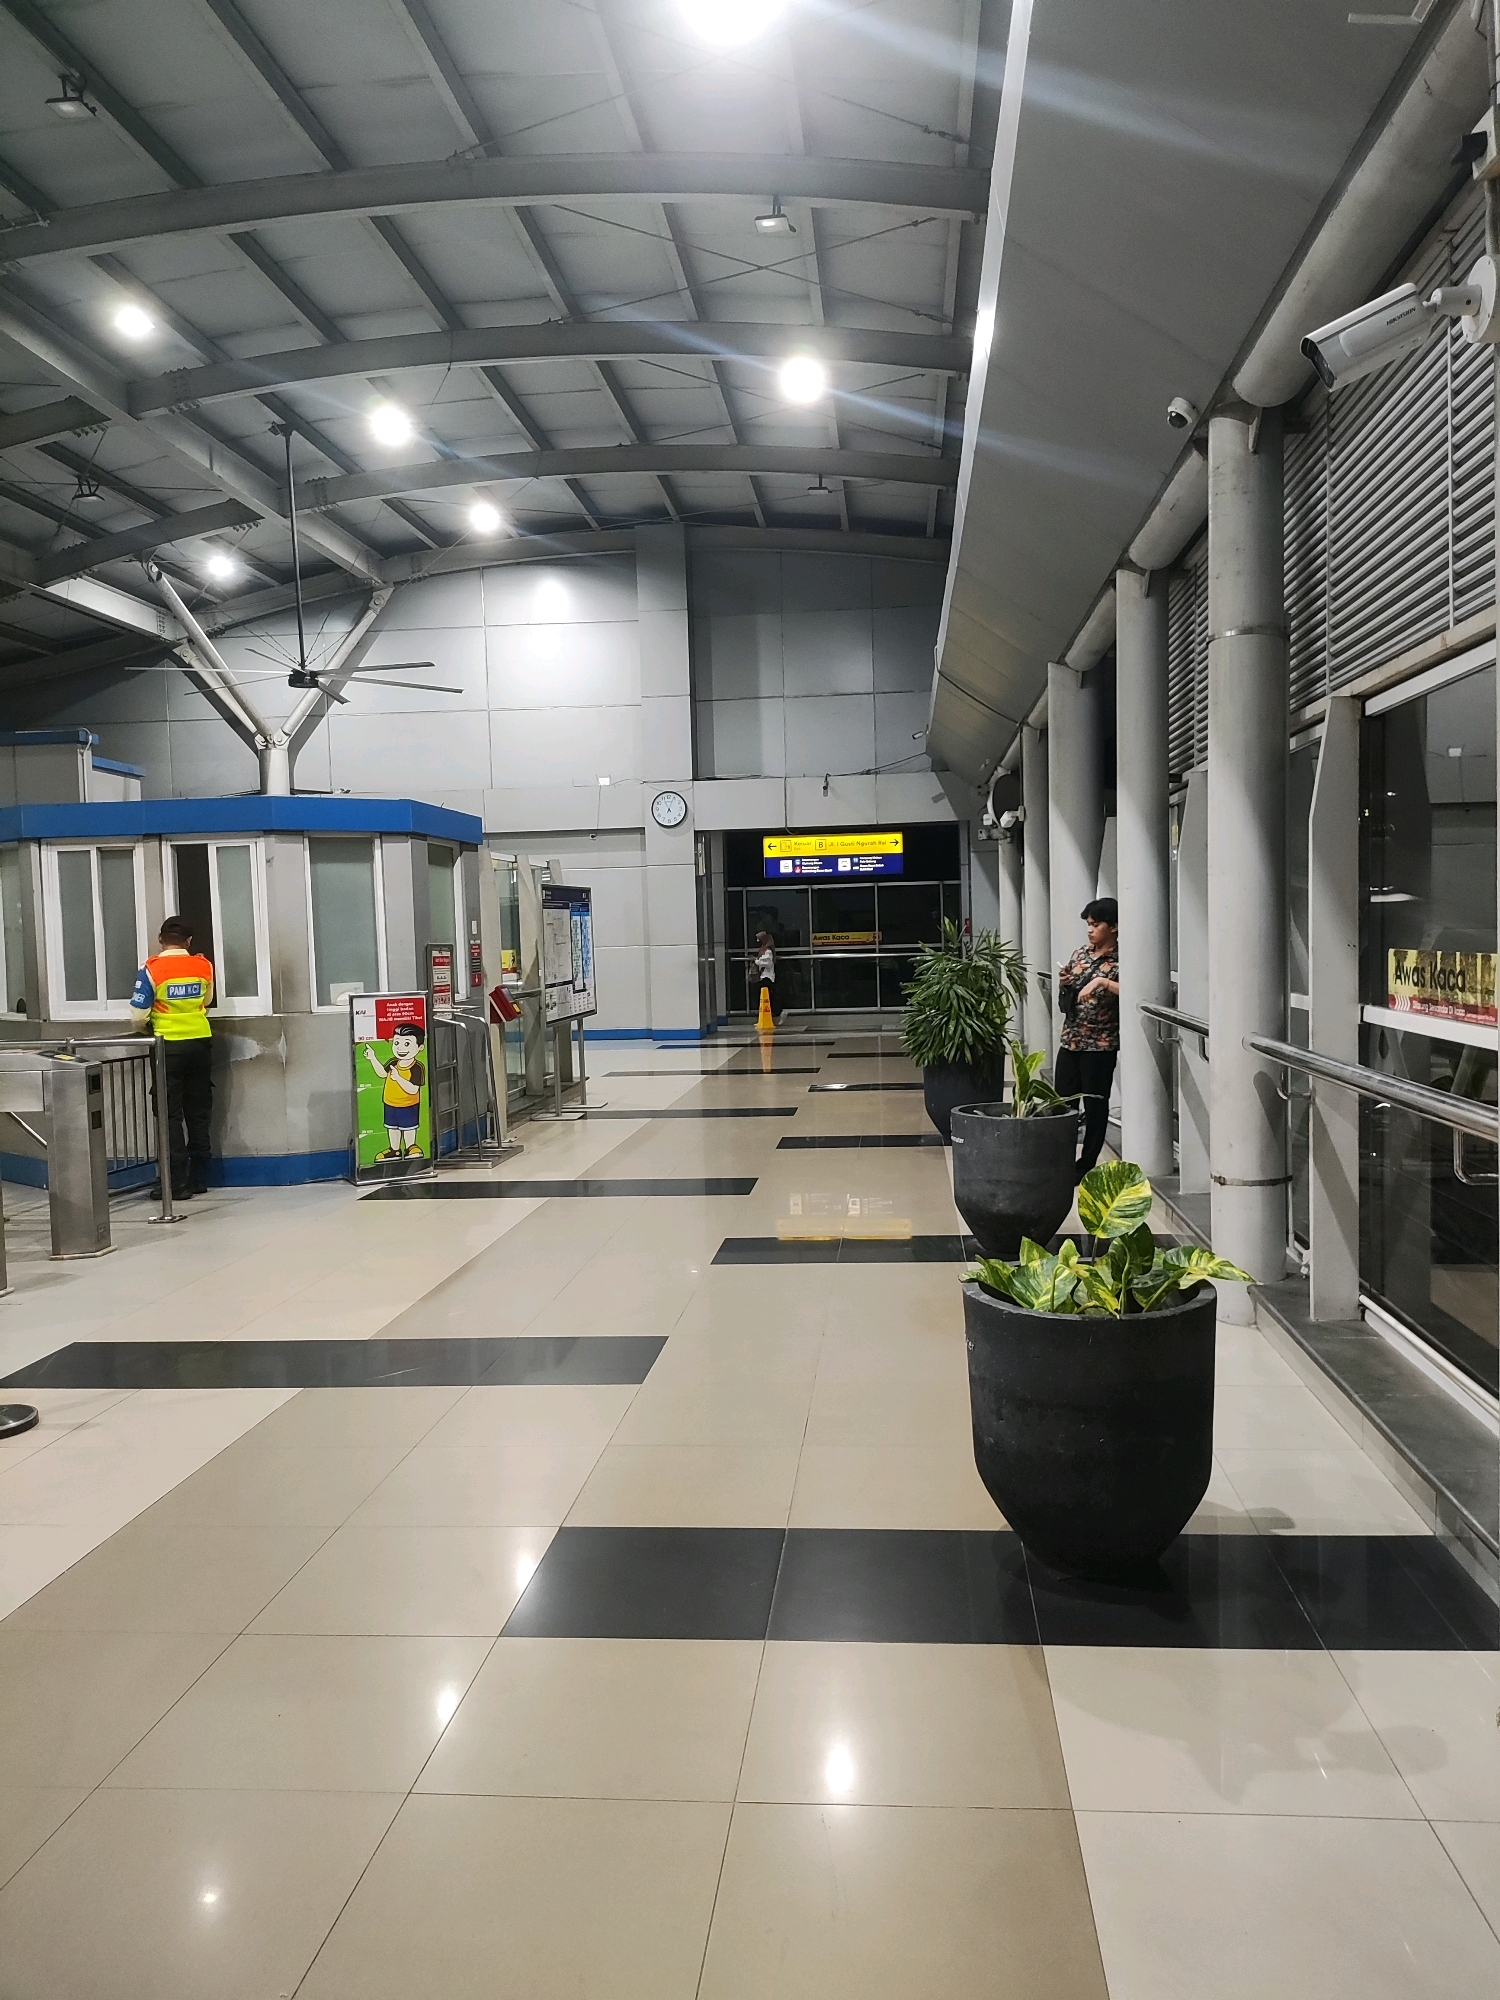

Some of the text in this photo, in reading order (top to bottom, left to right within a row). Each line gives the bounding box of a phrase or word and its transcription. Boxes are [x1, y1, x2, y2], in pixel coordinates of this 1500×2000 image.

[1386, 306, 1416, 326] HIKVISION
[856, 840, 877, 848] Ngurah
[1394, 958, 1466, 993] Awas Kaca
[169, 985, 186, 996] PAM
